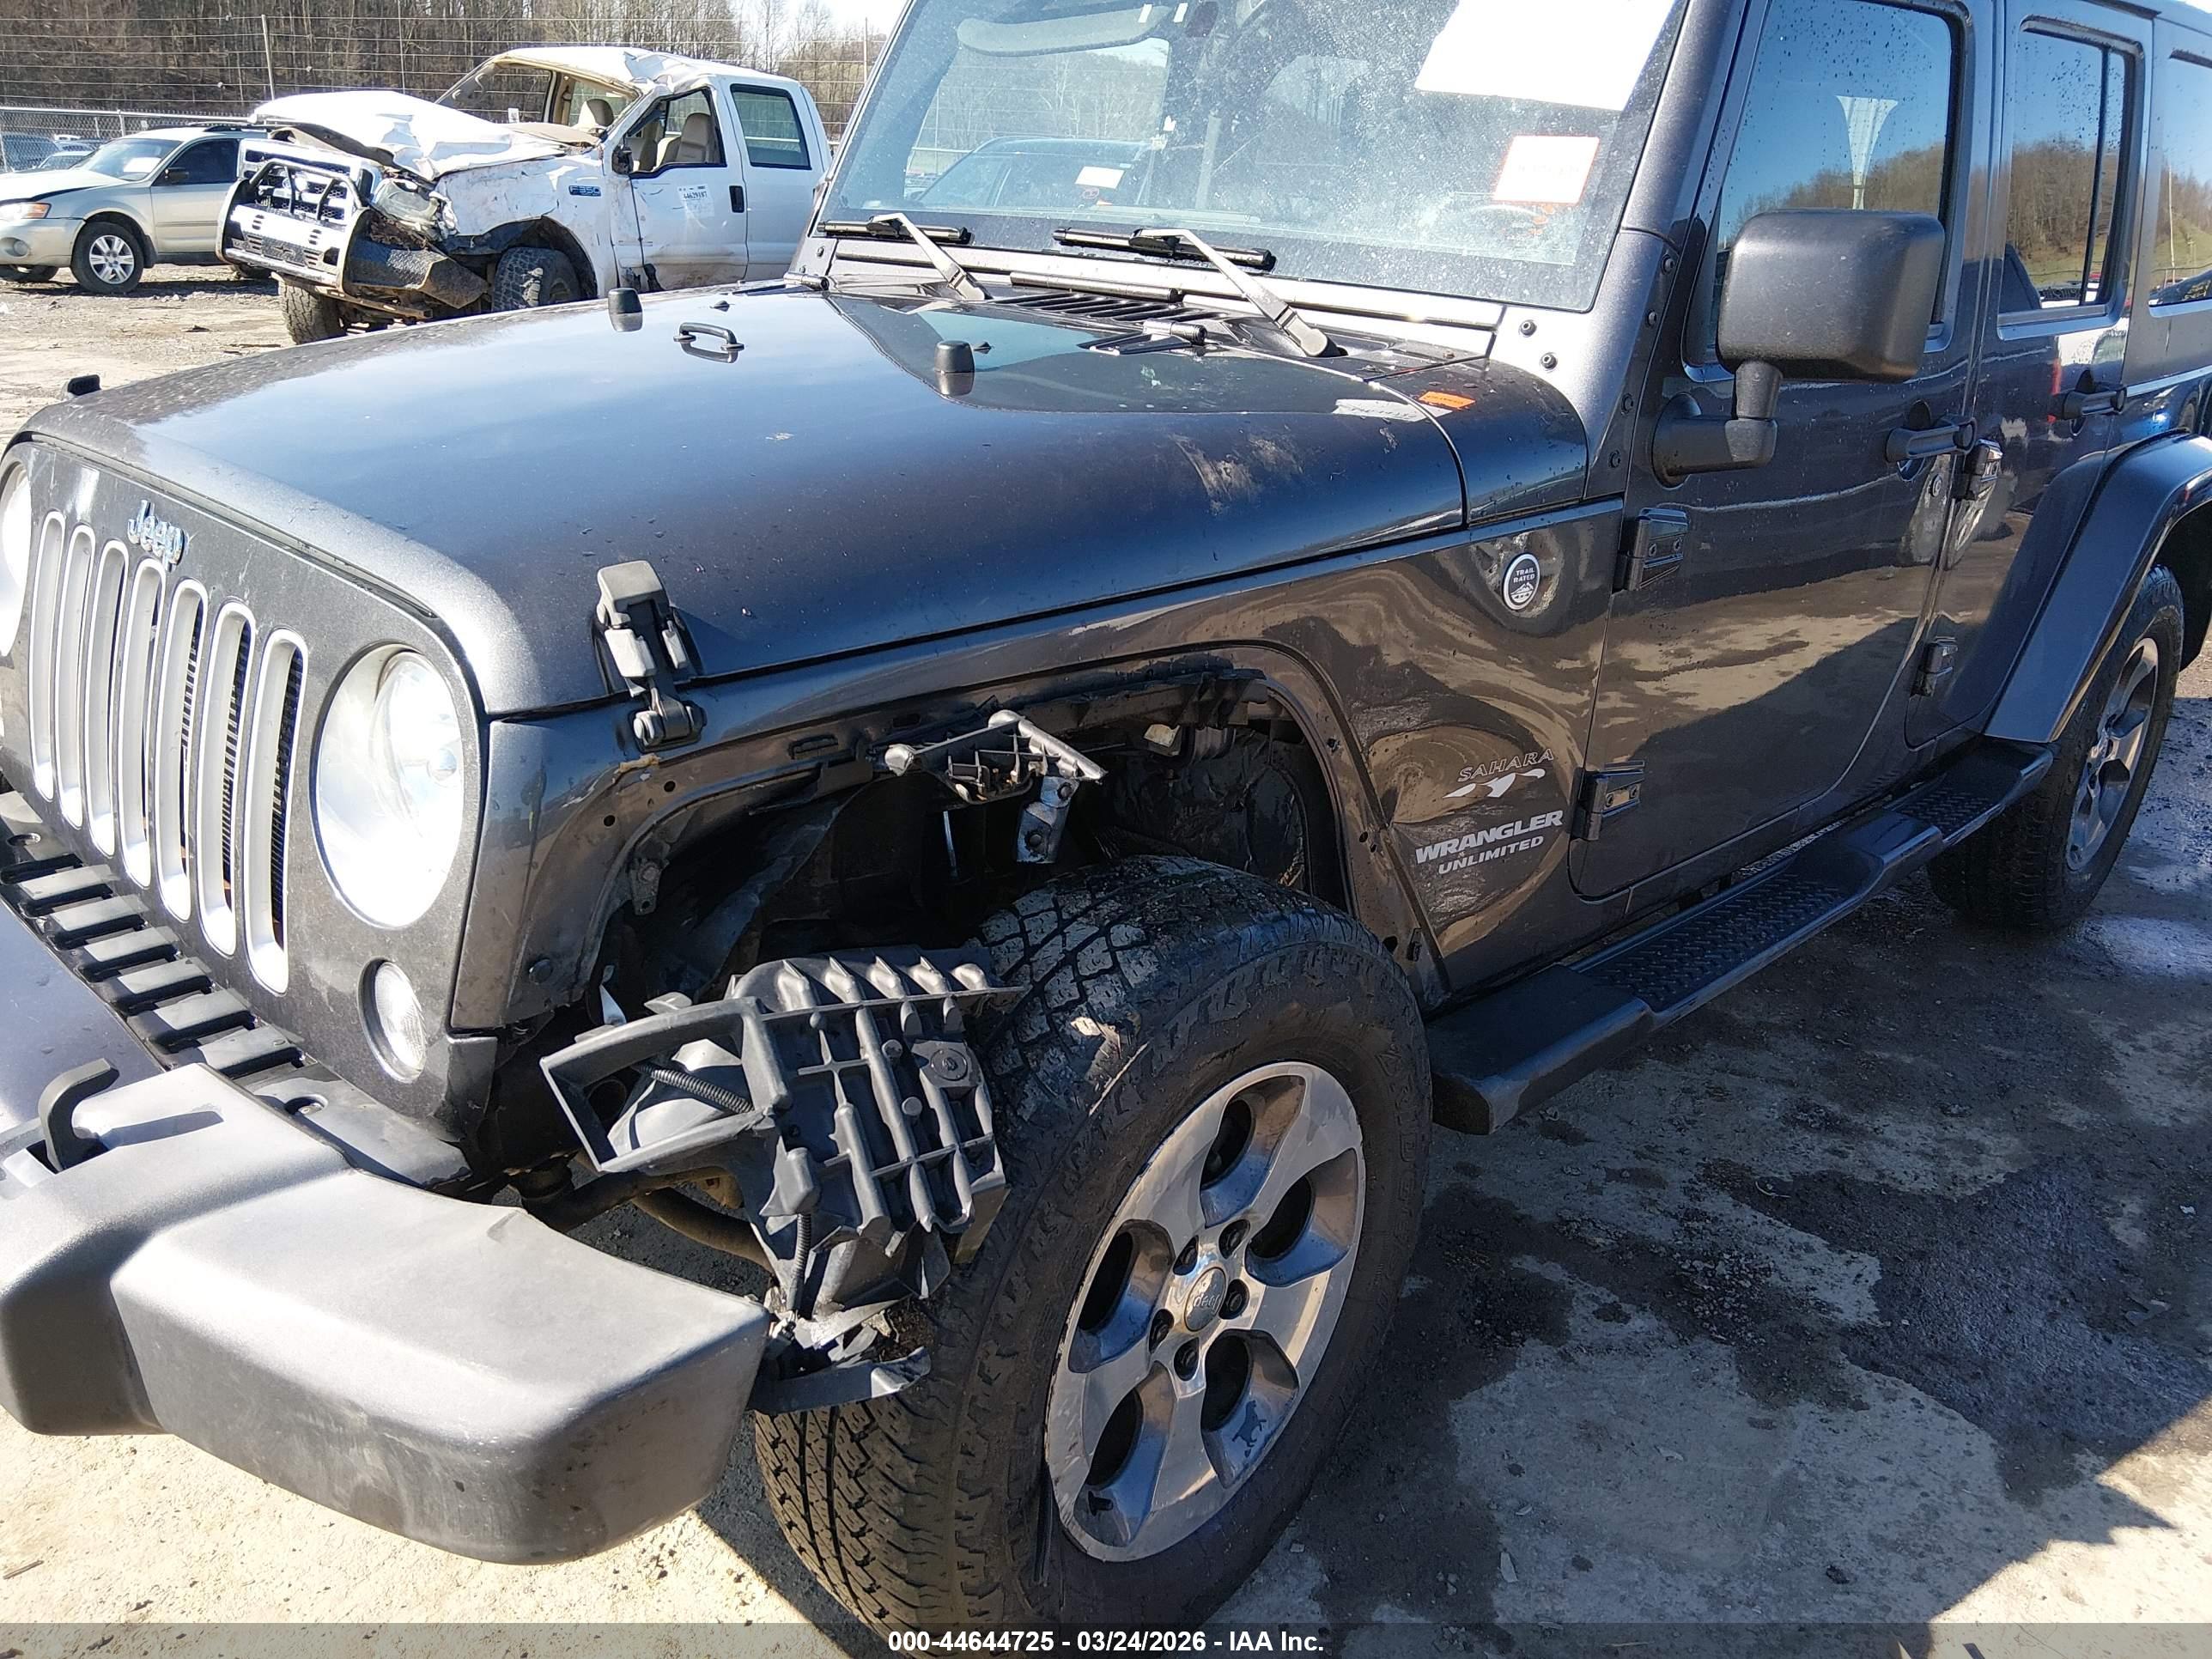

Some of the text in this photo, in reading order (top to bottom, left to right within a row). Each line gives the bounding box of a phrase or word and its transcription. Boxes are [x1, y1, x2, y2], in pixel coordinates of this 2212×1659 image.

[126, 499, 185, 572] Jeep
[1513, 574, 1535, 583] RATED
[1516, 567, 1535, 576] TRAIL
[1457, 748, 1553, 782] SAHARA
[1415, 810, 1564, 864] WRANGLER
[1438, 836, 1544, 874] UNLIMITED
